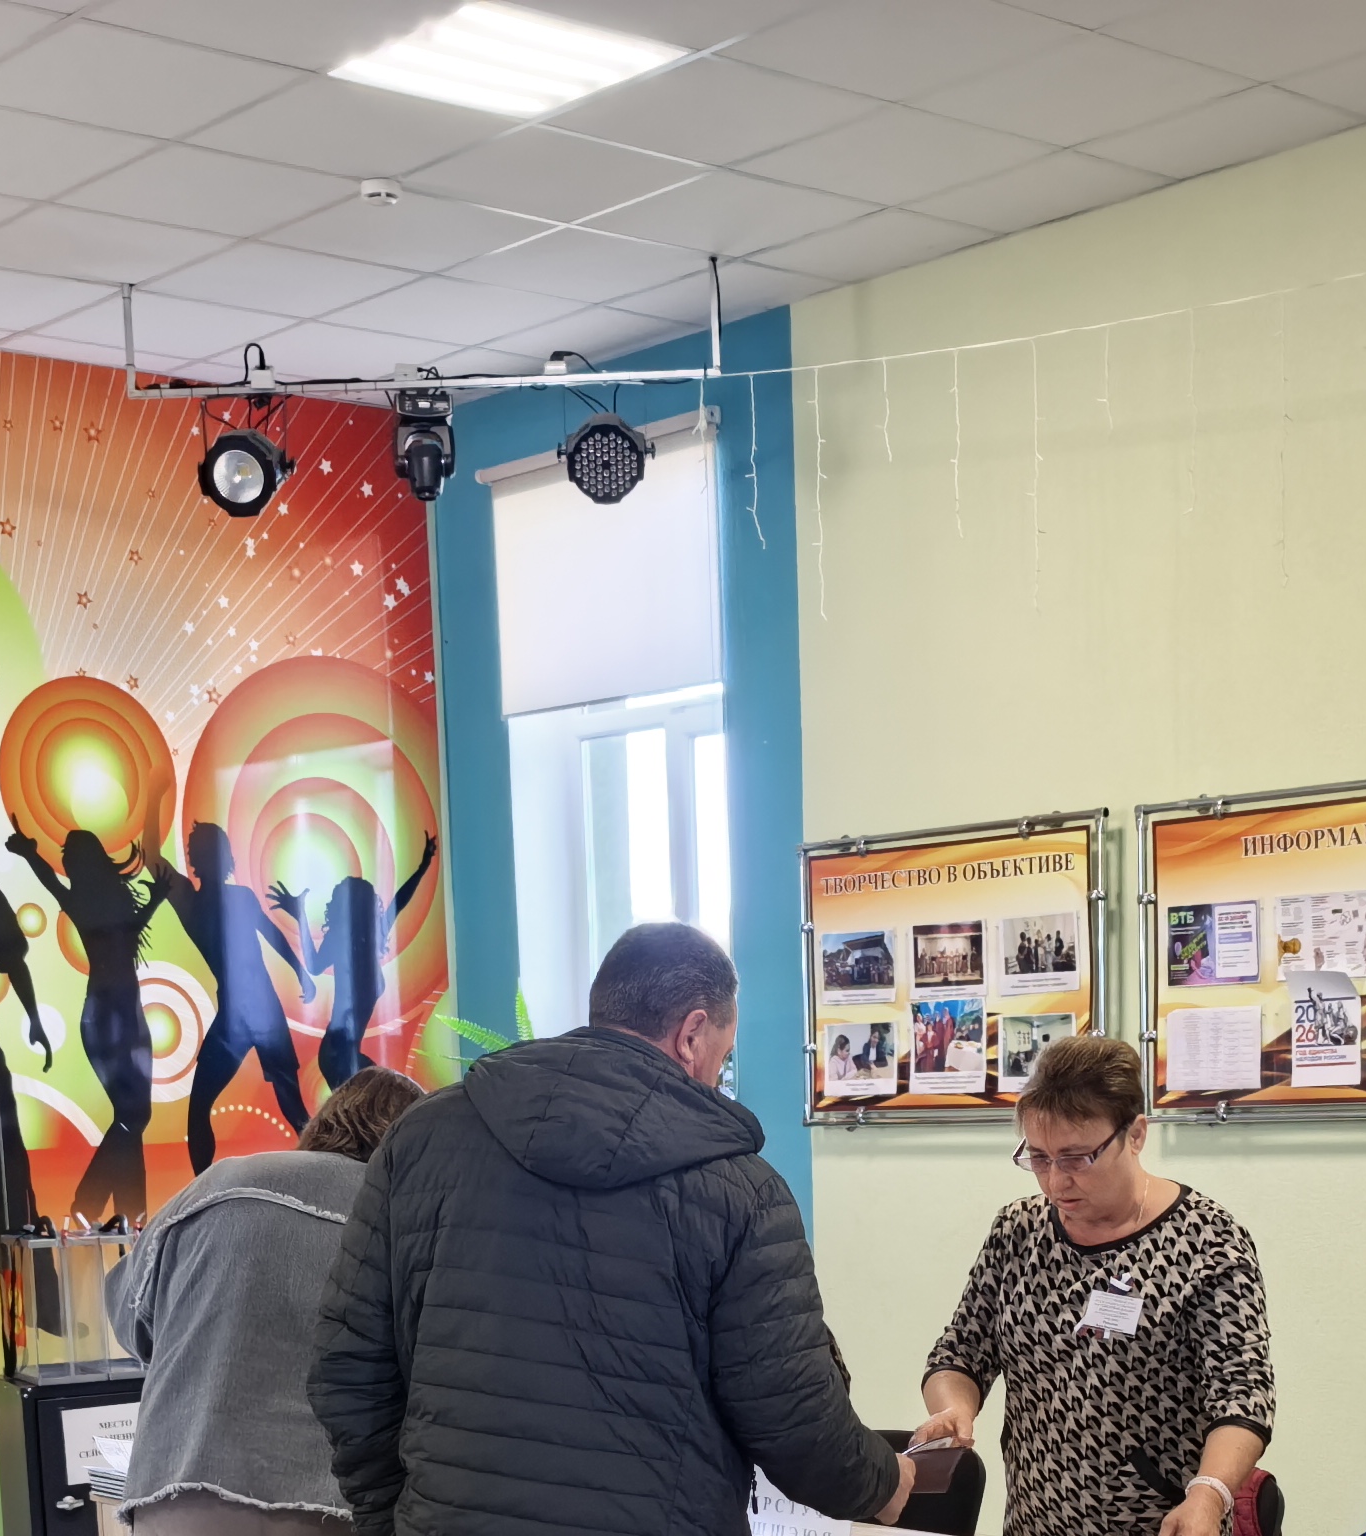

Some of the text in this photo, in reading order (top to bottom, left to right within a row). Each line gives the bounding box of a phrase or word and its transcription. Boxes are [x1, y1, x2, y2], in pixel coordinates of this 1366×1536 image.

[823, 852, 1076, 896] ТВОРЧЕСТВО В ОБЪЕКТИВЕ
[1169, 911, 1195, 925] ВТБ
[1295, 1004, 1316, 1023] 20
[1295, 1024, 1316, 1043] 26
[99, 1420, 133, 1429] МЕСТО
